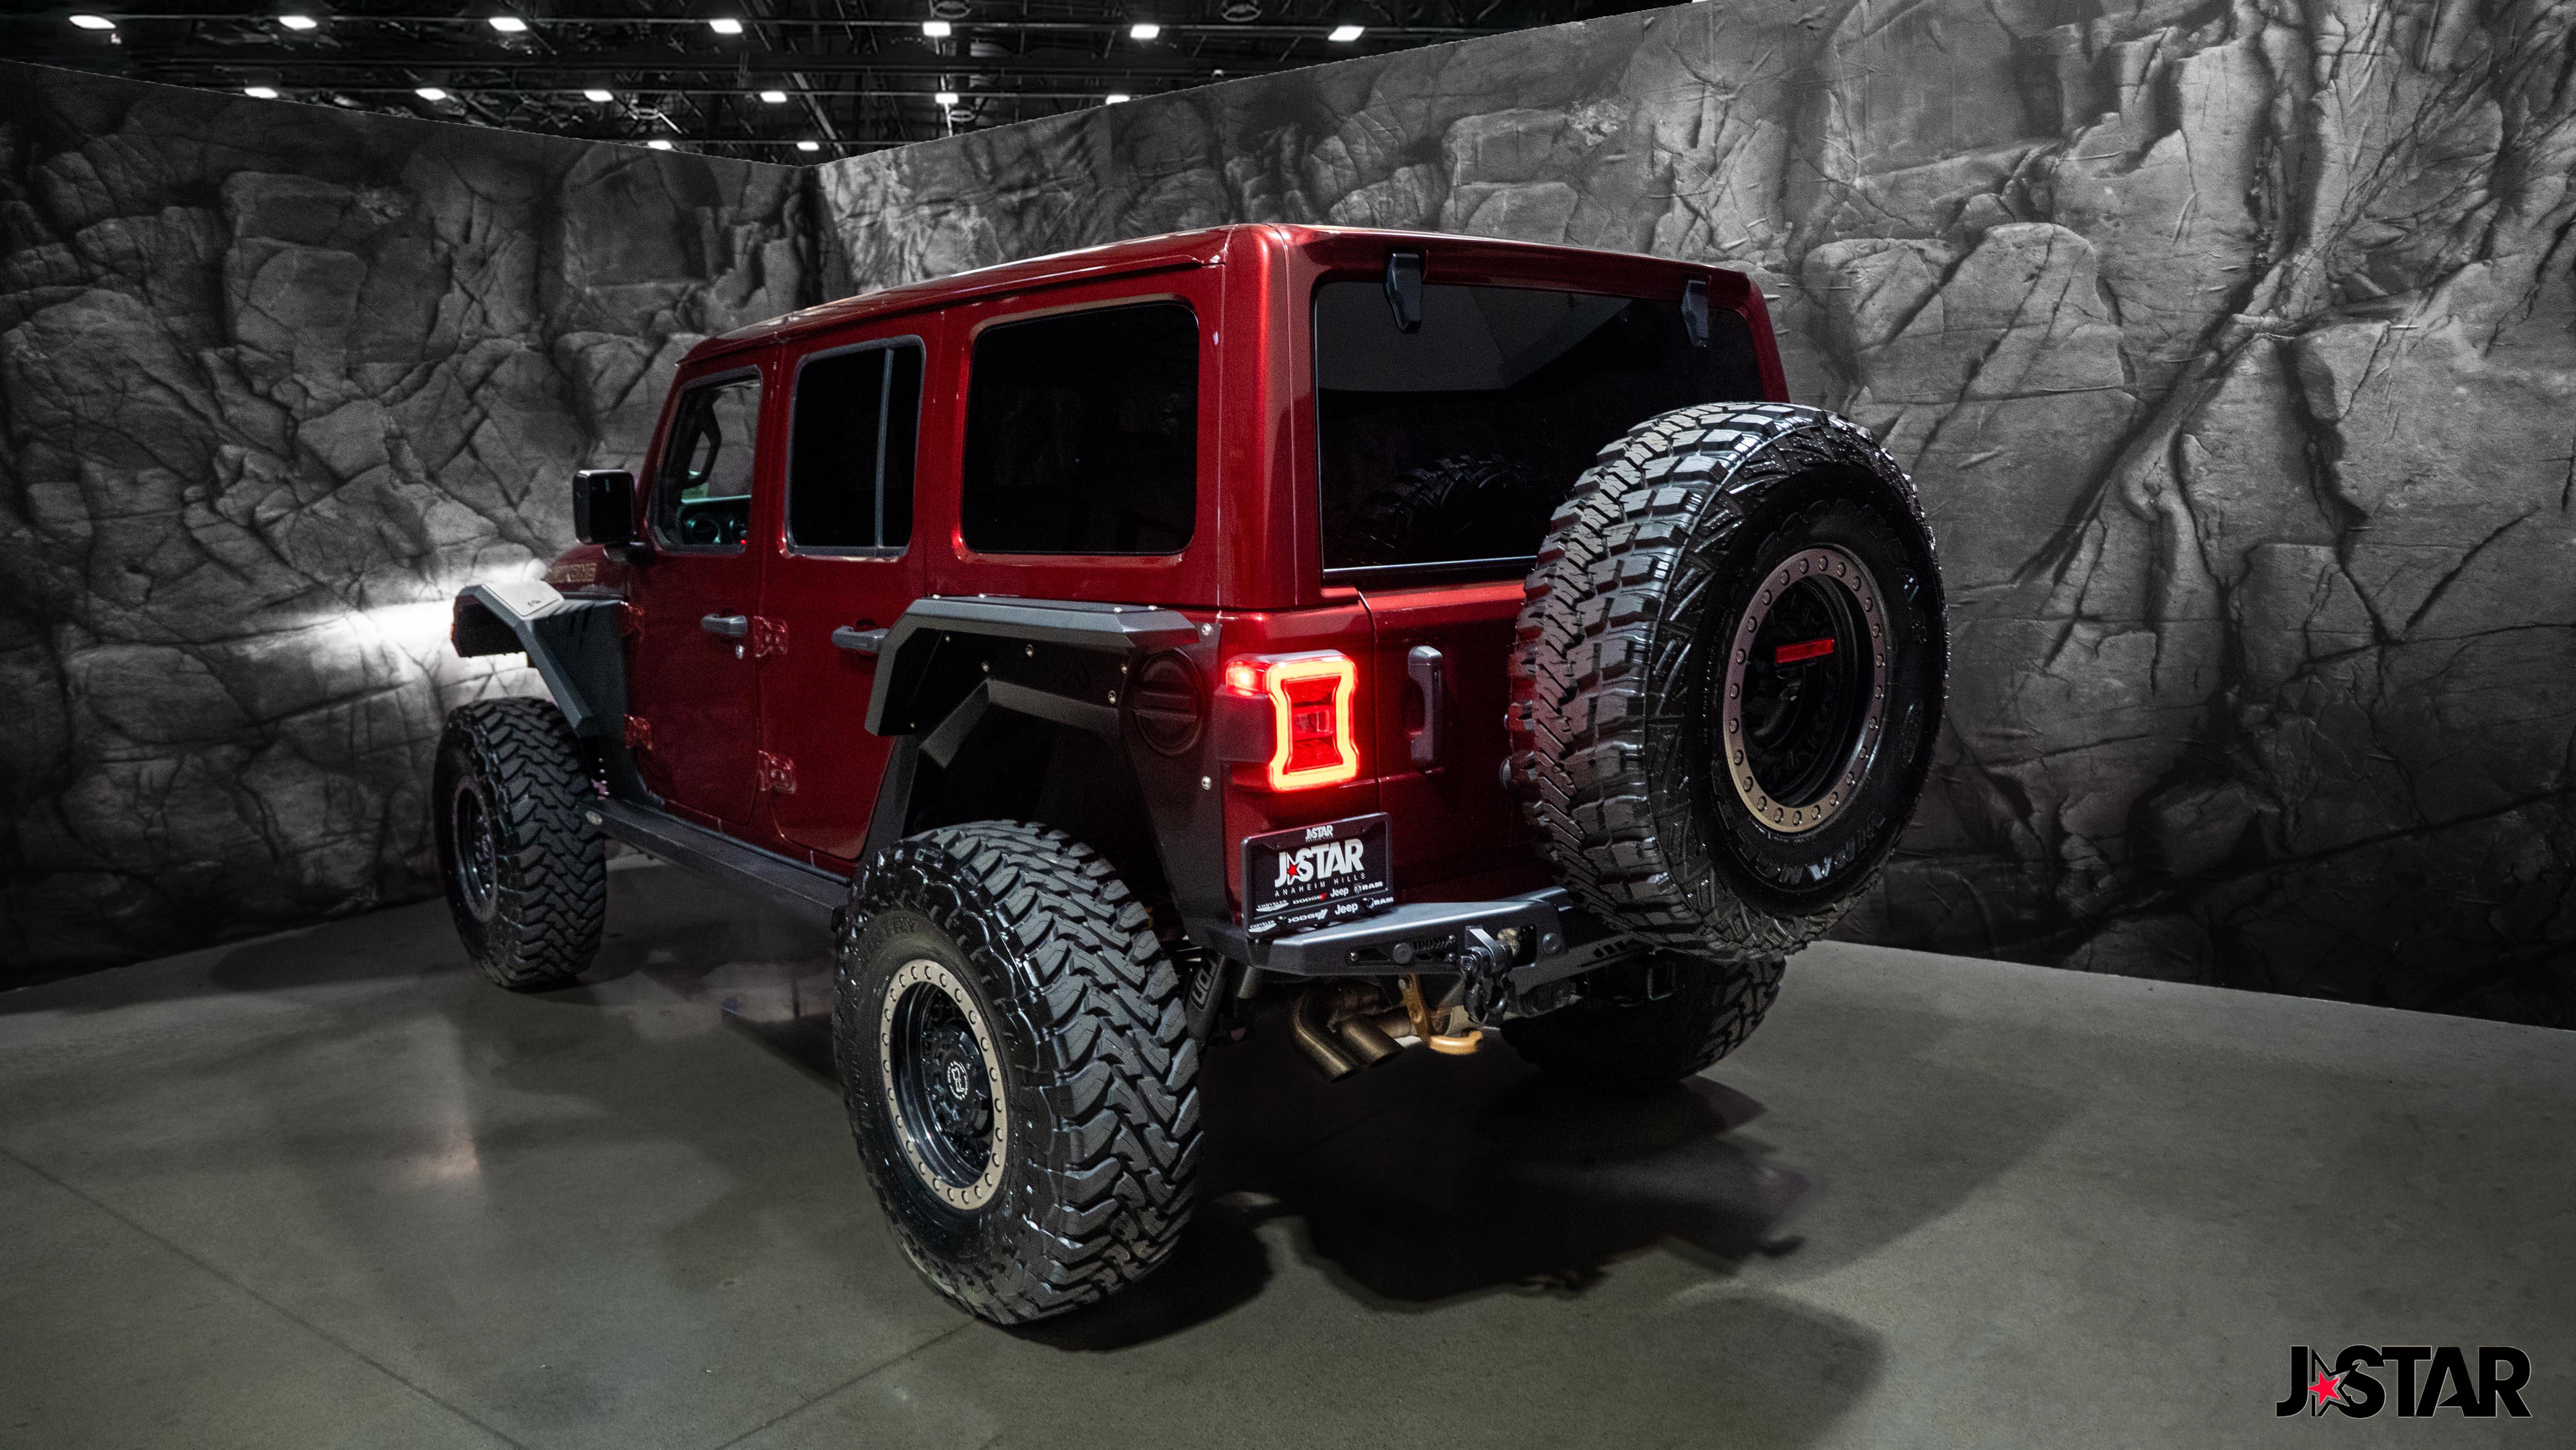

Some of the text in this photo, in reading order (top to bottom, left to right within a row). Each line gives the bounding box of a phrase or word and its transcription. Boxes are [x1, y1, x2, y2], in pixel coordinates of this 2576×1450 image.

[1257, 881, 1383, 909] CHRYSLER DODGE Jeep RAM
[1275, 872, 1366, 897] ANAHEIM HILLS
[1250, 920, 1275, 929] CHRYSLER
[1334, 903, 1358, 915] Jeep
[1373, 896, 1394, 907] RAM
